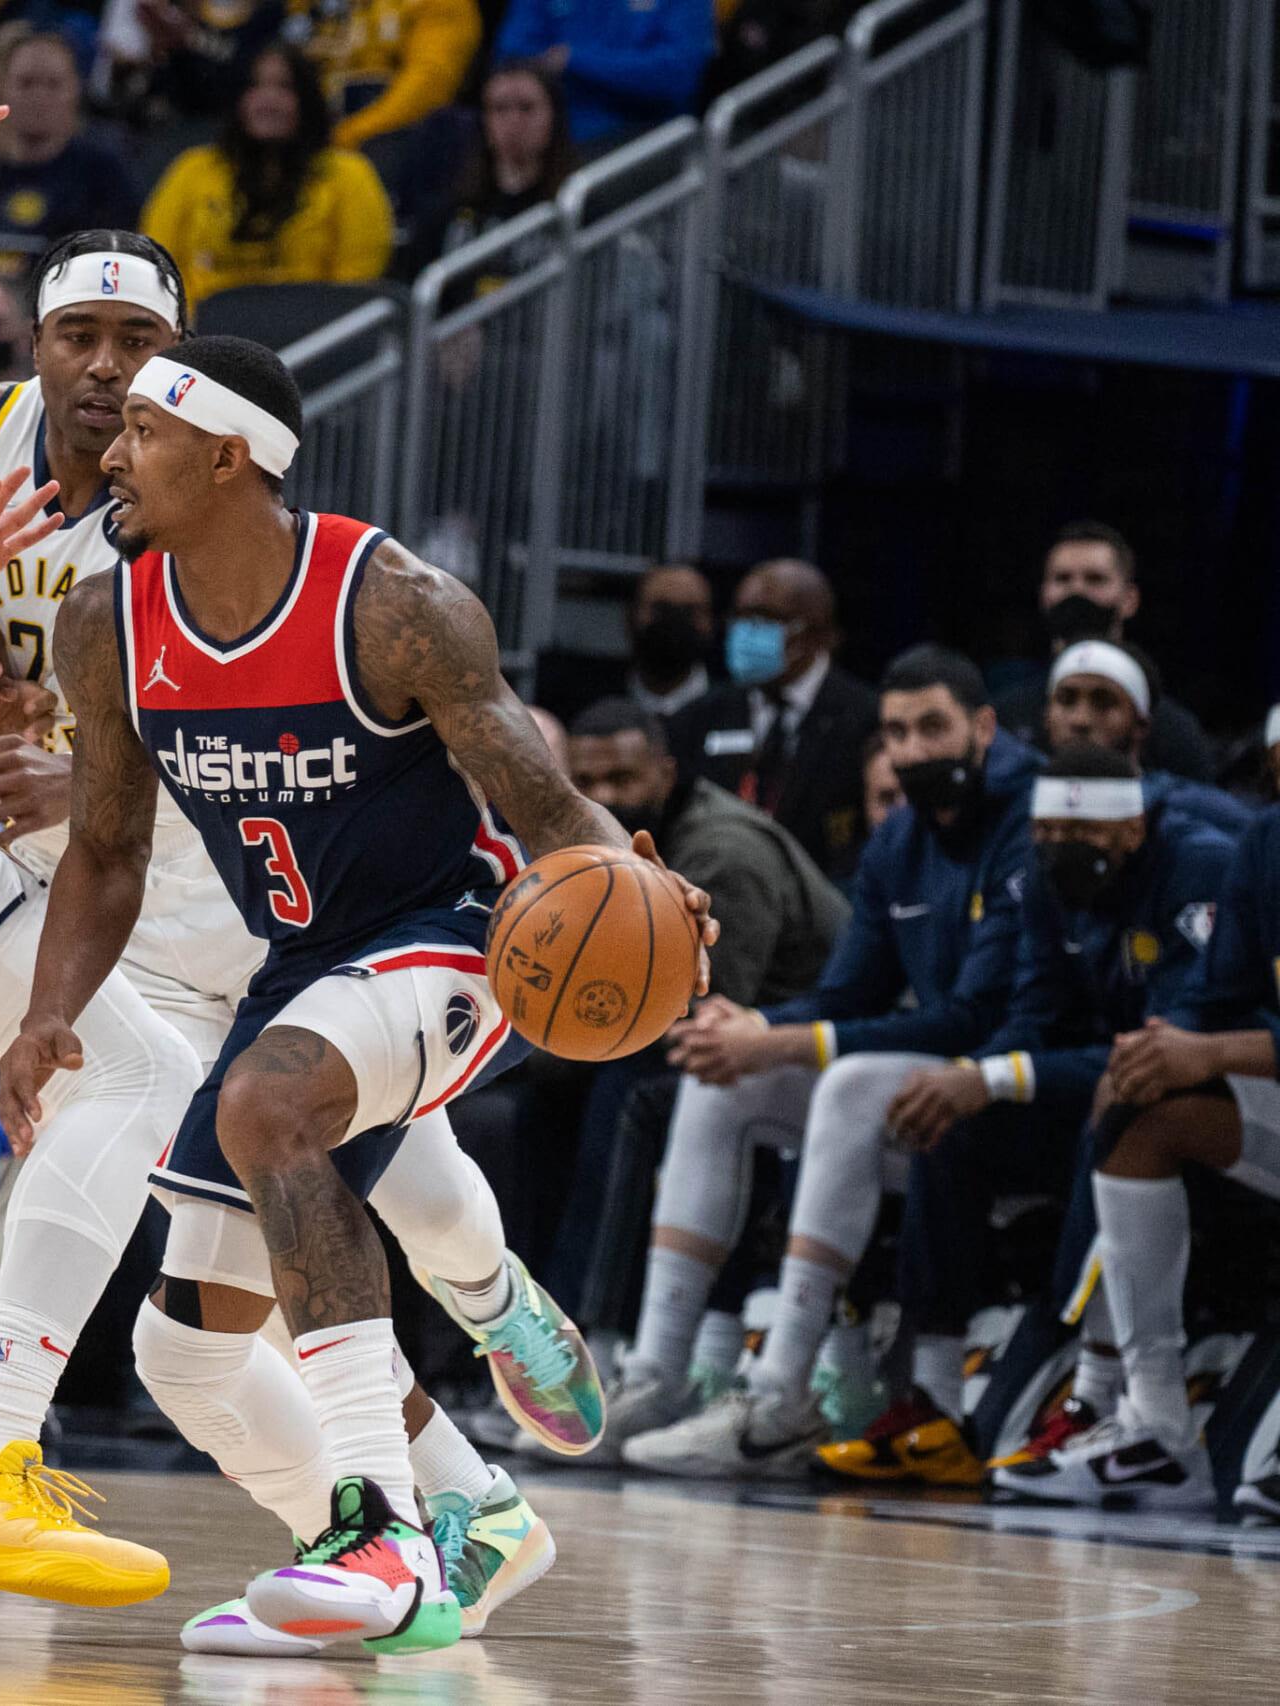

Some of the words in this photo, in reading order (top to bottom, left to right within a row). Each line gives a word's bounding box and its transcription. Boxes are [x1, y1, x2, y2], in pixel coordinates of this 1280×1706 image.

[157, 727, 357, 792] district
[195, 735, 228, 751] THE
[205, 784, 357, 803] COLUMBI
[238, 817, 314, 928] 3
